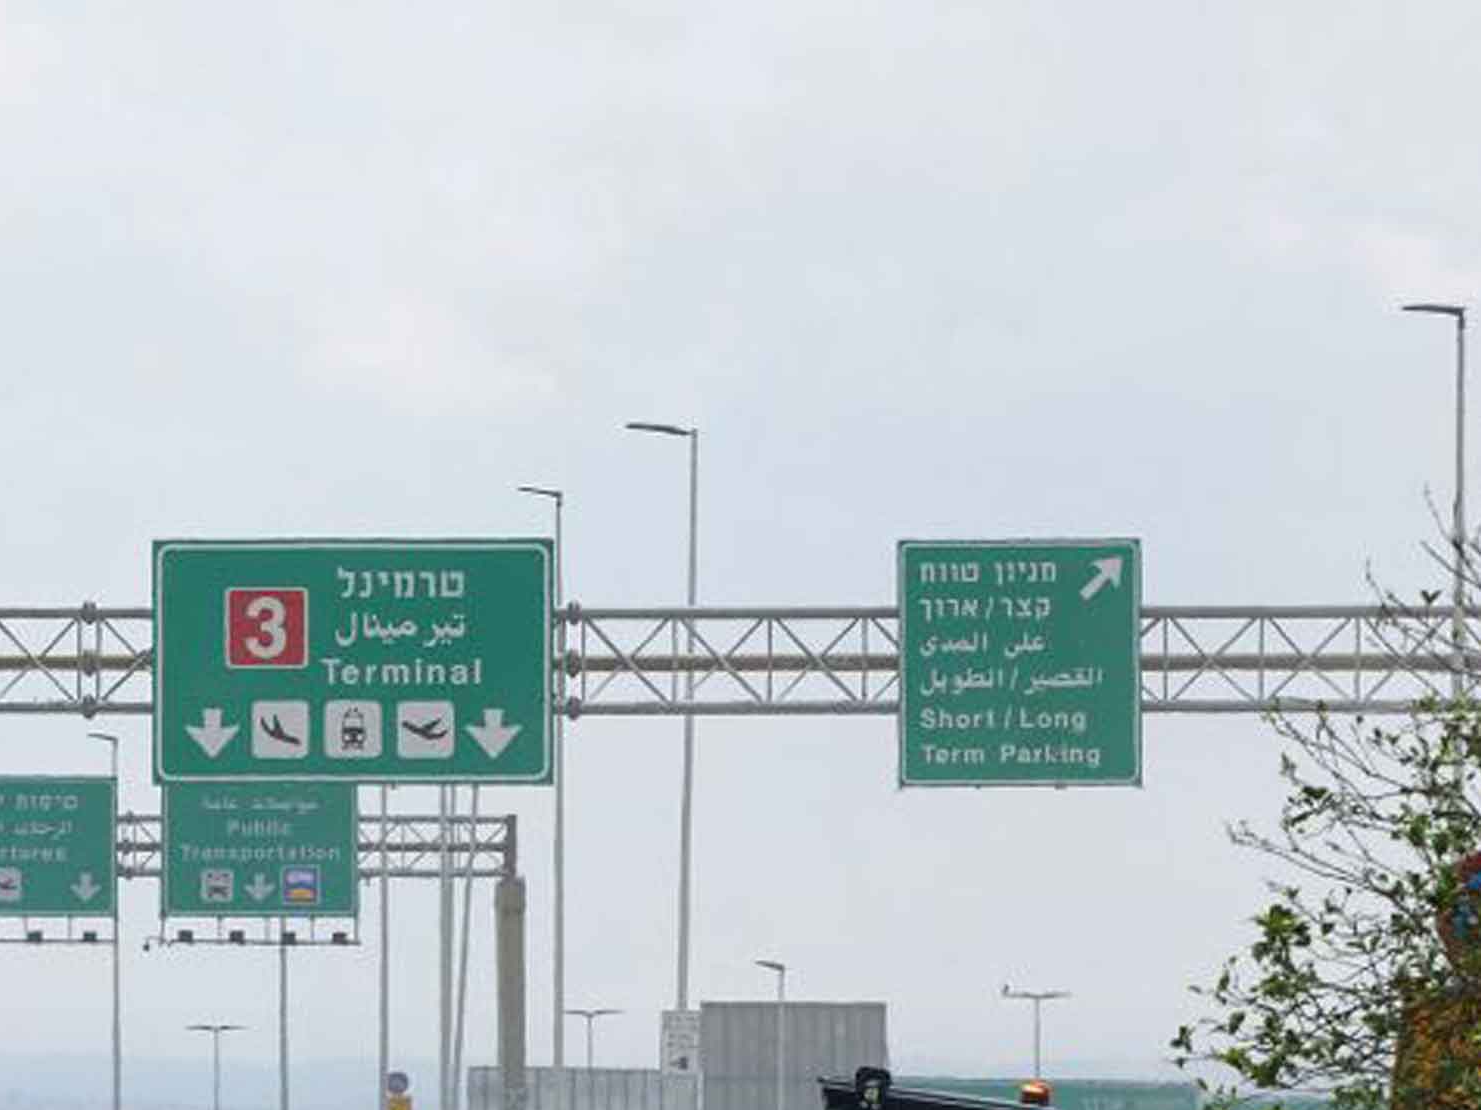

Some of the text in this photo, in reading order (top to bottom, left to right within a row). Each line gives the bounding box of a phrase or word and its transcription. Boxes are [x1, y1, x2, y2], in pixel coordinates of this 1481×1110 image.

[337, 566, 466, 599] טרמינל
[919, 562, 1057, 585] חניון טווח
[245, 597, 288, 659] 3
[321, 658, 483, 687] Terminal
[923, 743, 1102, 768] Term Parking
[228, 819, 292, 838] Public
[182, 844, 343, 865] Transportation
